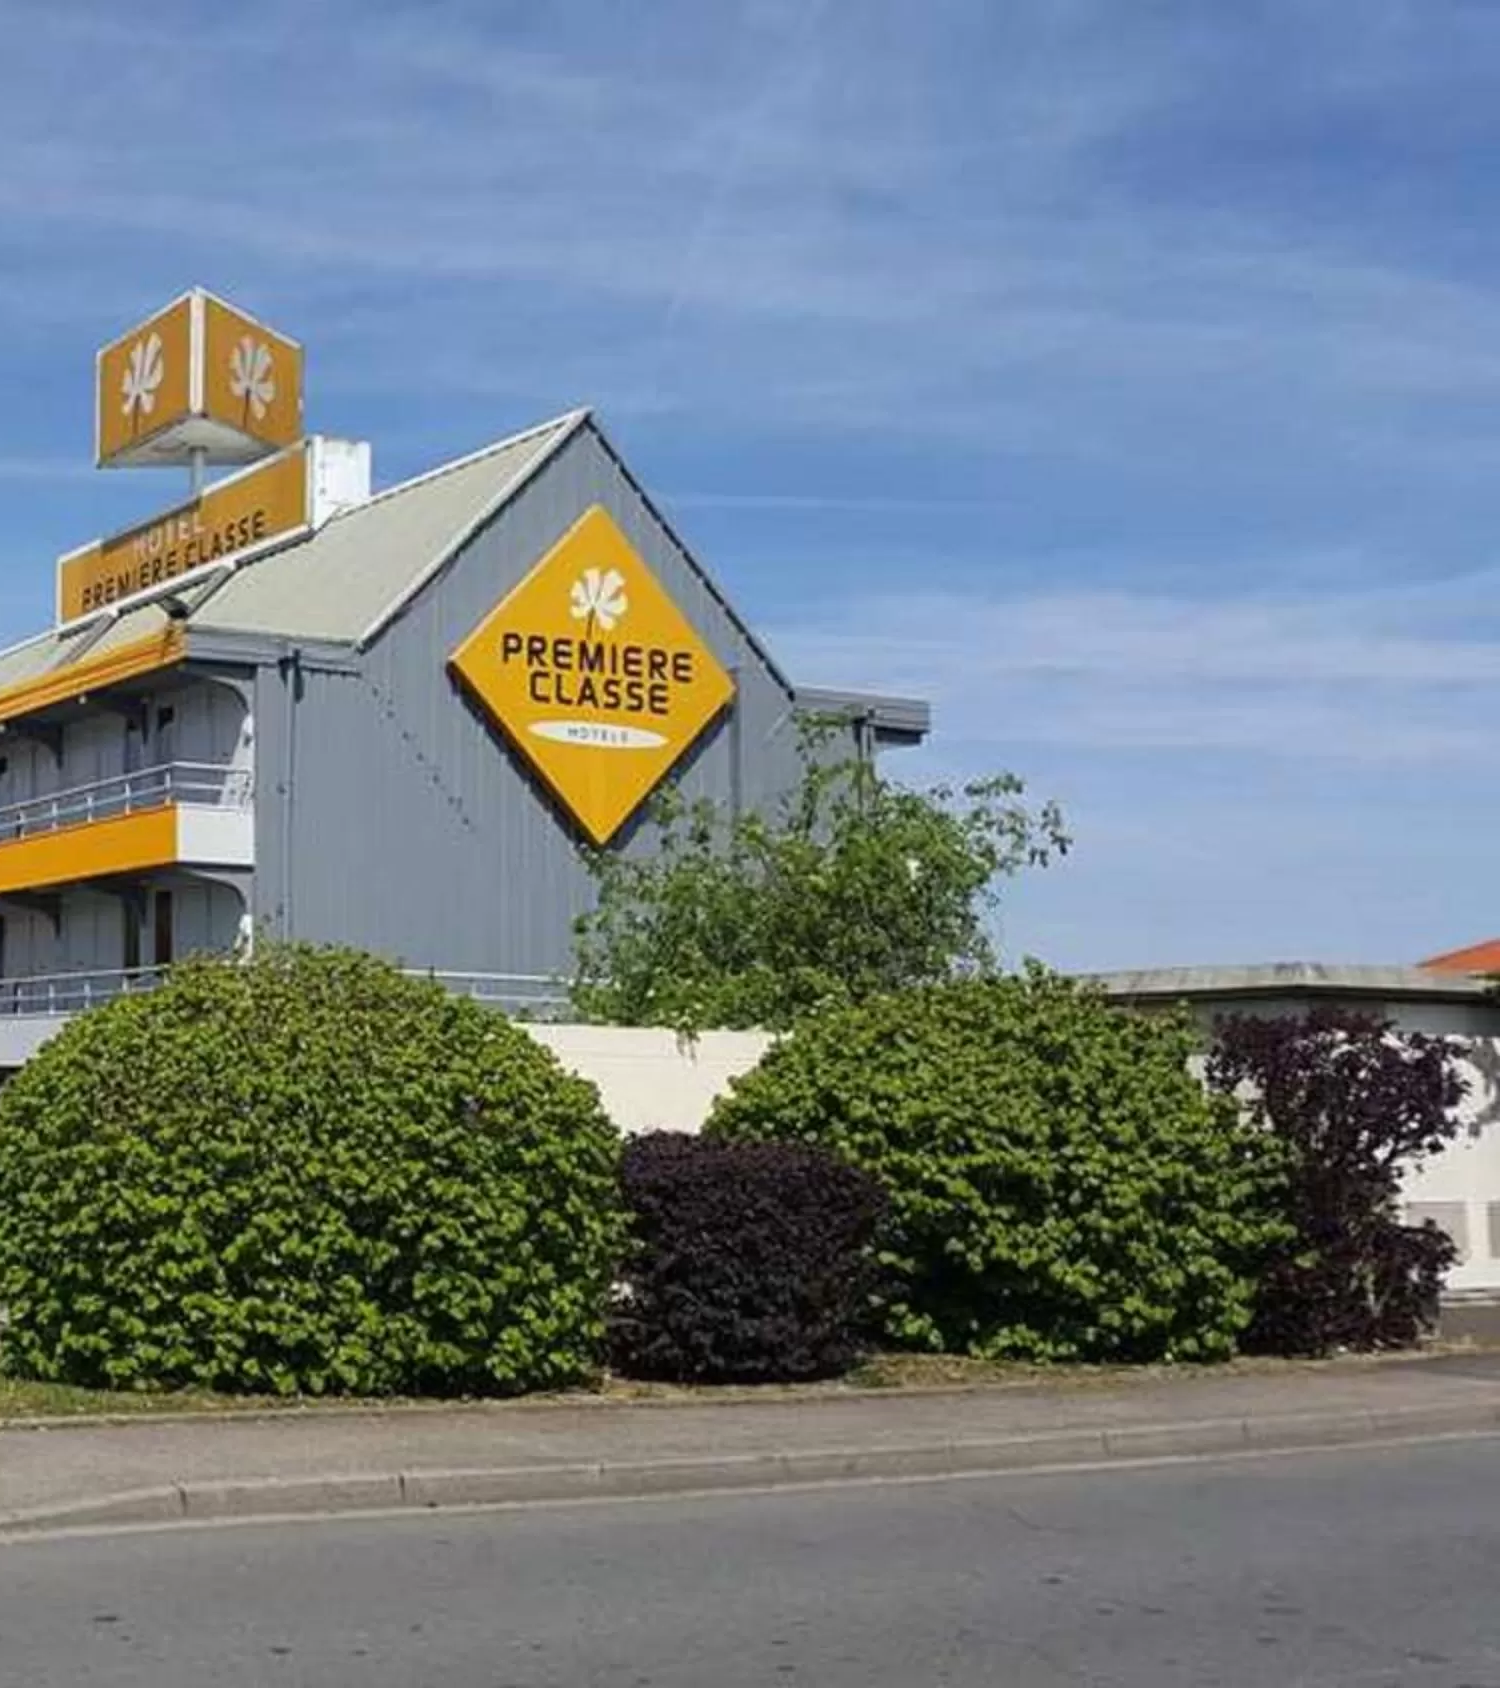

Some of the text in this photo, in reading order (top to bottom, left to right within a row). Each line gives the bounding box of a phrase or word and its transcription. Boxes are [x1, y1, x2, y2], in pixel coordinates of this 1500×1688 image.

[82, 510, 266, 610] PREMIERE CLASSE
[502, 633, 692, 682] PREMIERE
[529, 671, 669, 714] CLASSE
